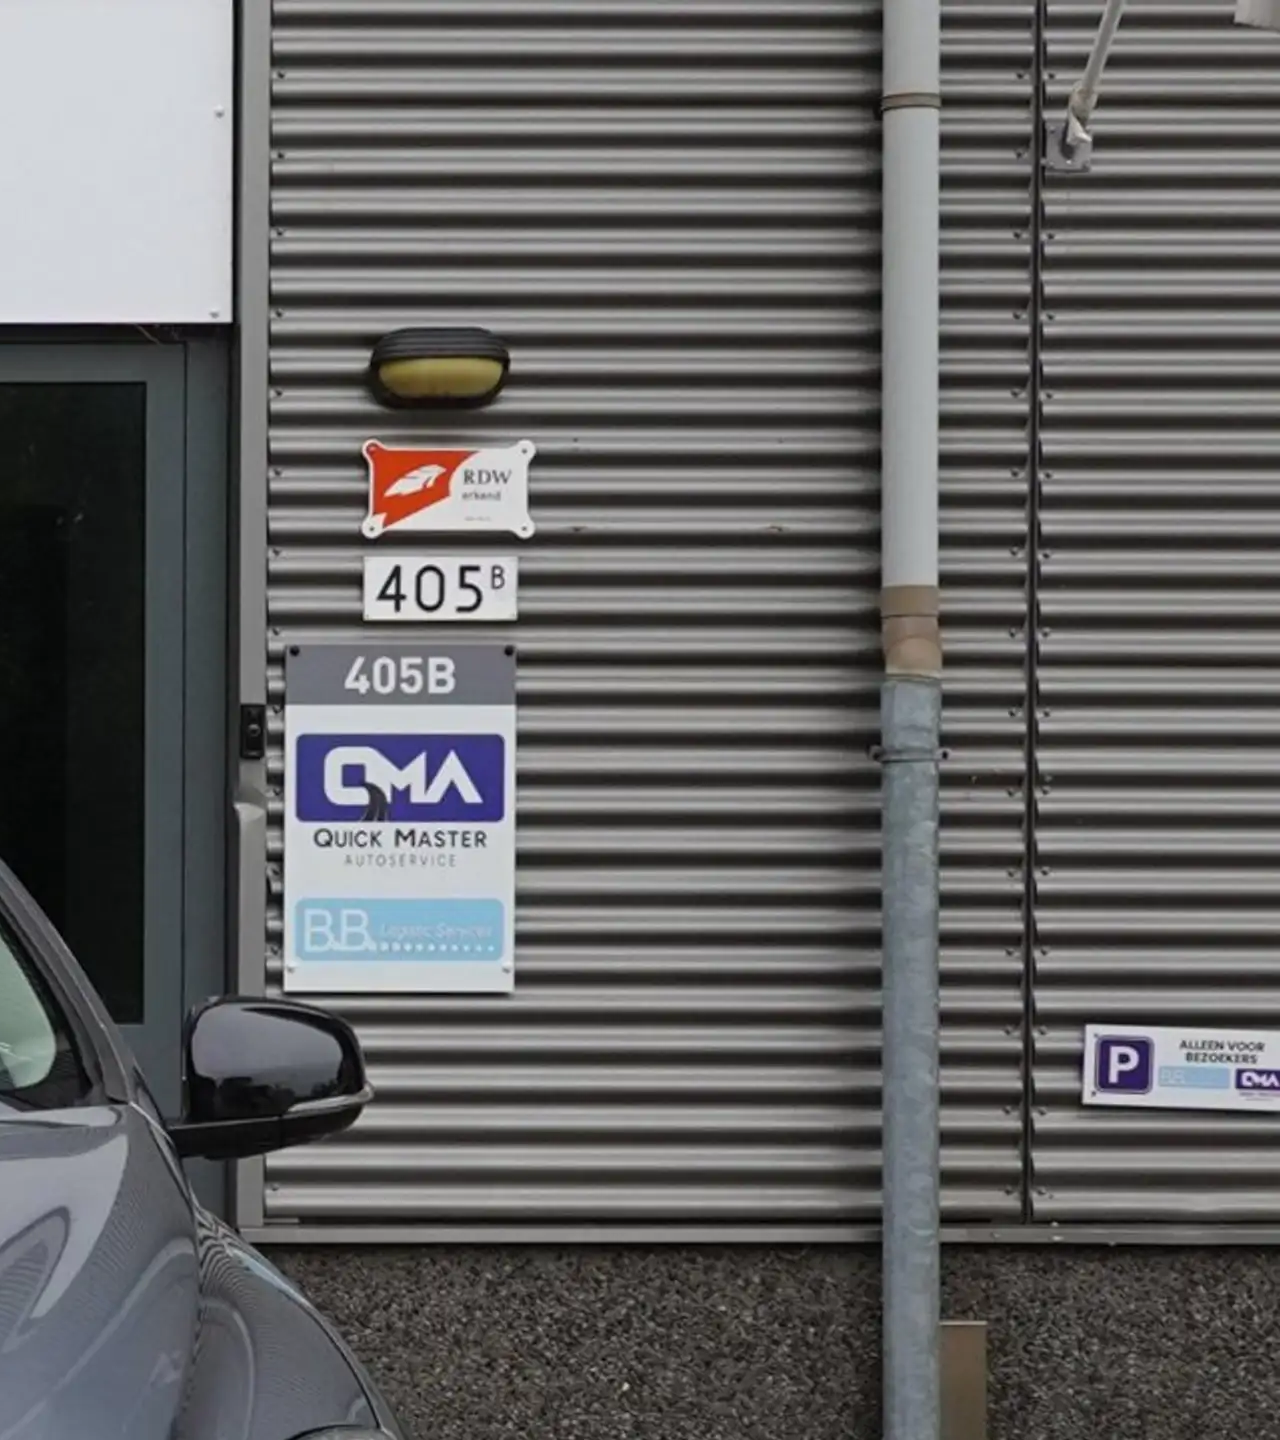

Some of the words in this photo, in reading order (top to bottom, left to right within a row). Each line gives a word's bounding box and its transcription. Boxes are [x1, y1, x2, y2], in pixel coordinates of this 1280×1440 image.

[463, 468, 513, 485] RDW
[344, 656, 457, 695] 405B
[313, 828, 383, 848] QUICK
[394, 828, 488, 848] MASTER
[344, 854, 457, 868] AUTOSERVICE
[1179, 1040, 1225, 1050] ALLEEN
[1227, 1041, 1266, 1052] VOOR
[1108, 1046, 1139, 1083] P
[1185, 1052, 1258, 1064] BEZOEKERS
